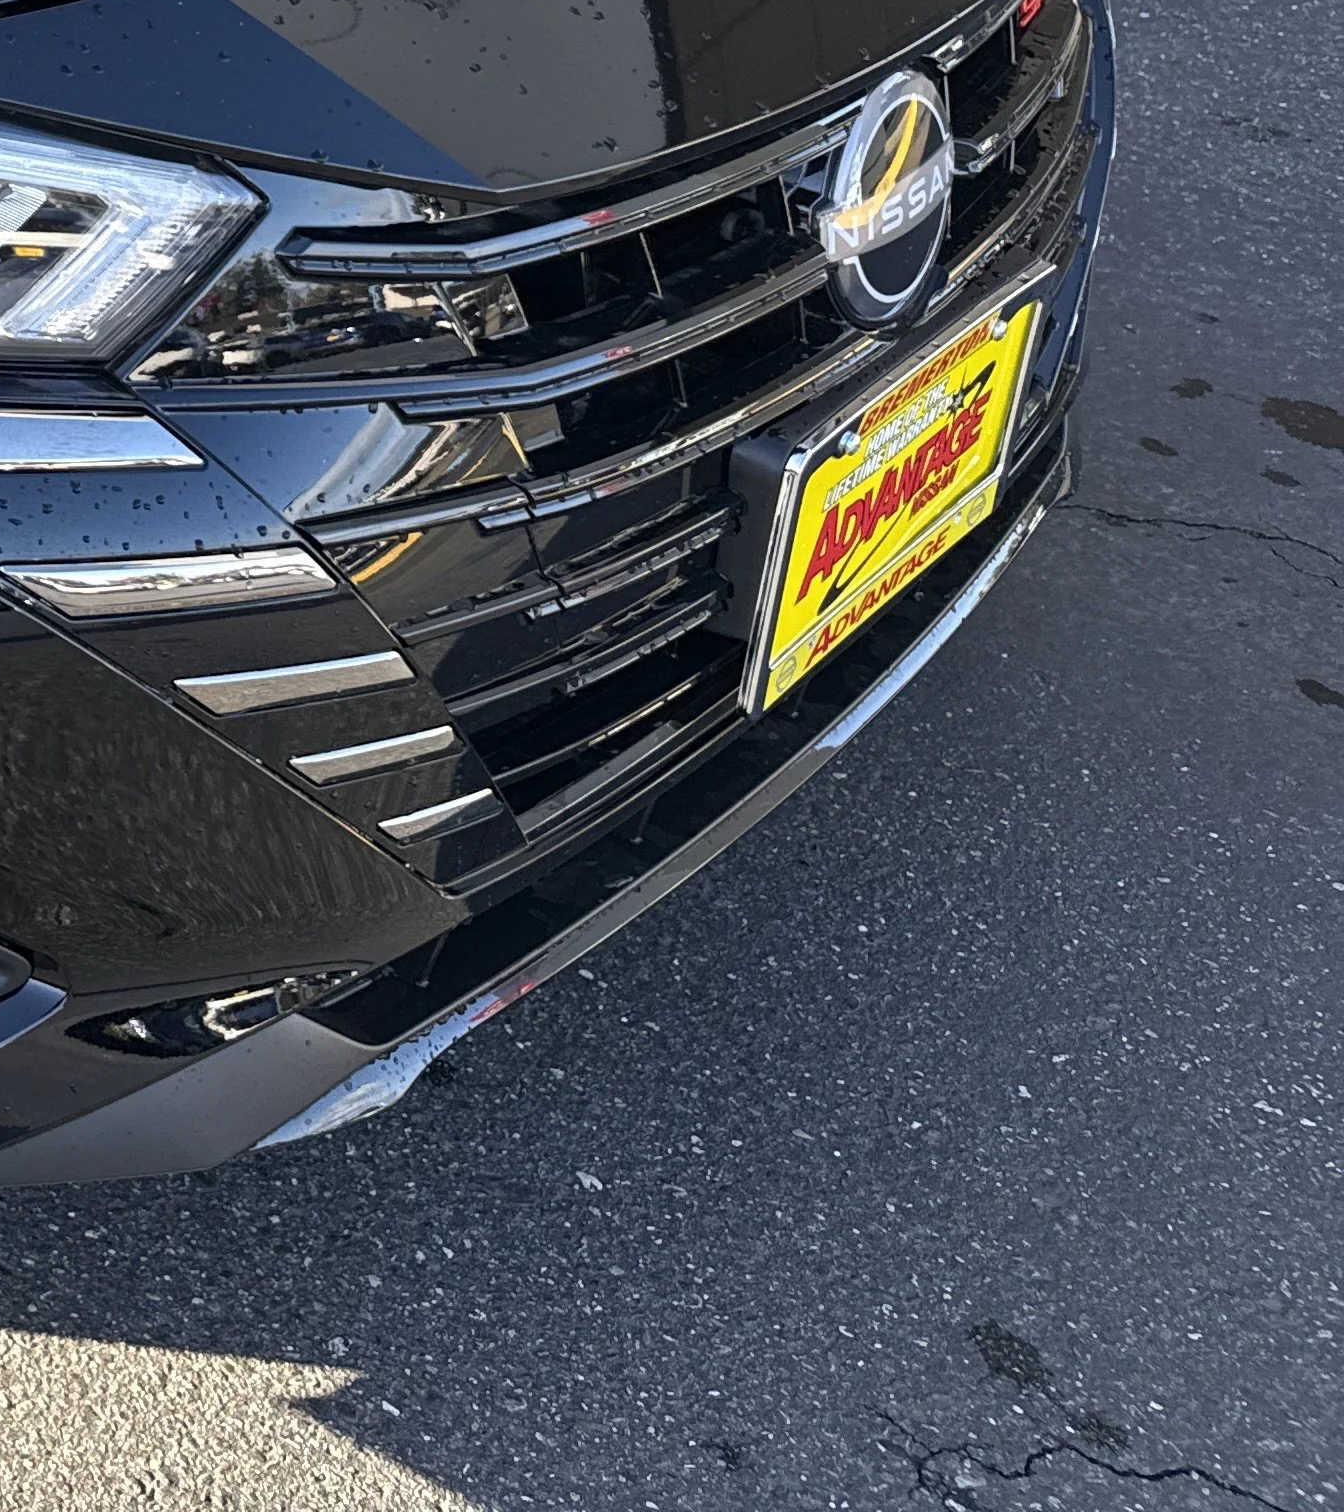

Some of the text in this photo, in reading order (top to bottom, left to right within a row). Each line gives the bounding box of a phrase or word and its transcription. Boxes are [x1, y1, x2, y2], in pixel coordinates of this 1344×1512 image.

[828, 148, 955, 256] NISSAN
[823, 394, 954, 509] LIFETIME WARRANTY
[865, 409, 907, 457] HOME
[794, 388, 993, 606] ADVANTAGE
[803, 524, 953, 672] ADVANTAGE
